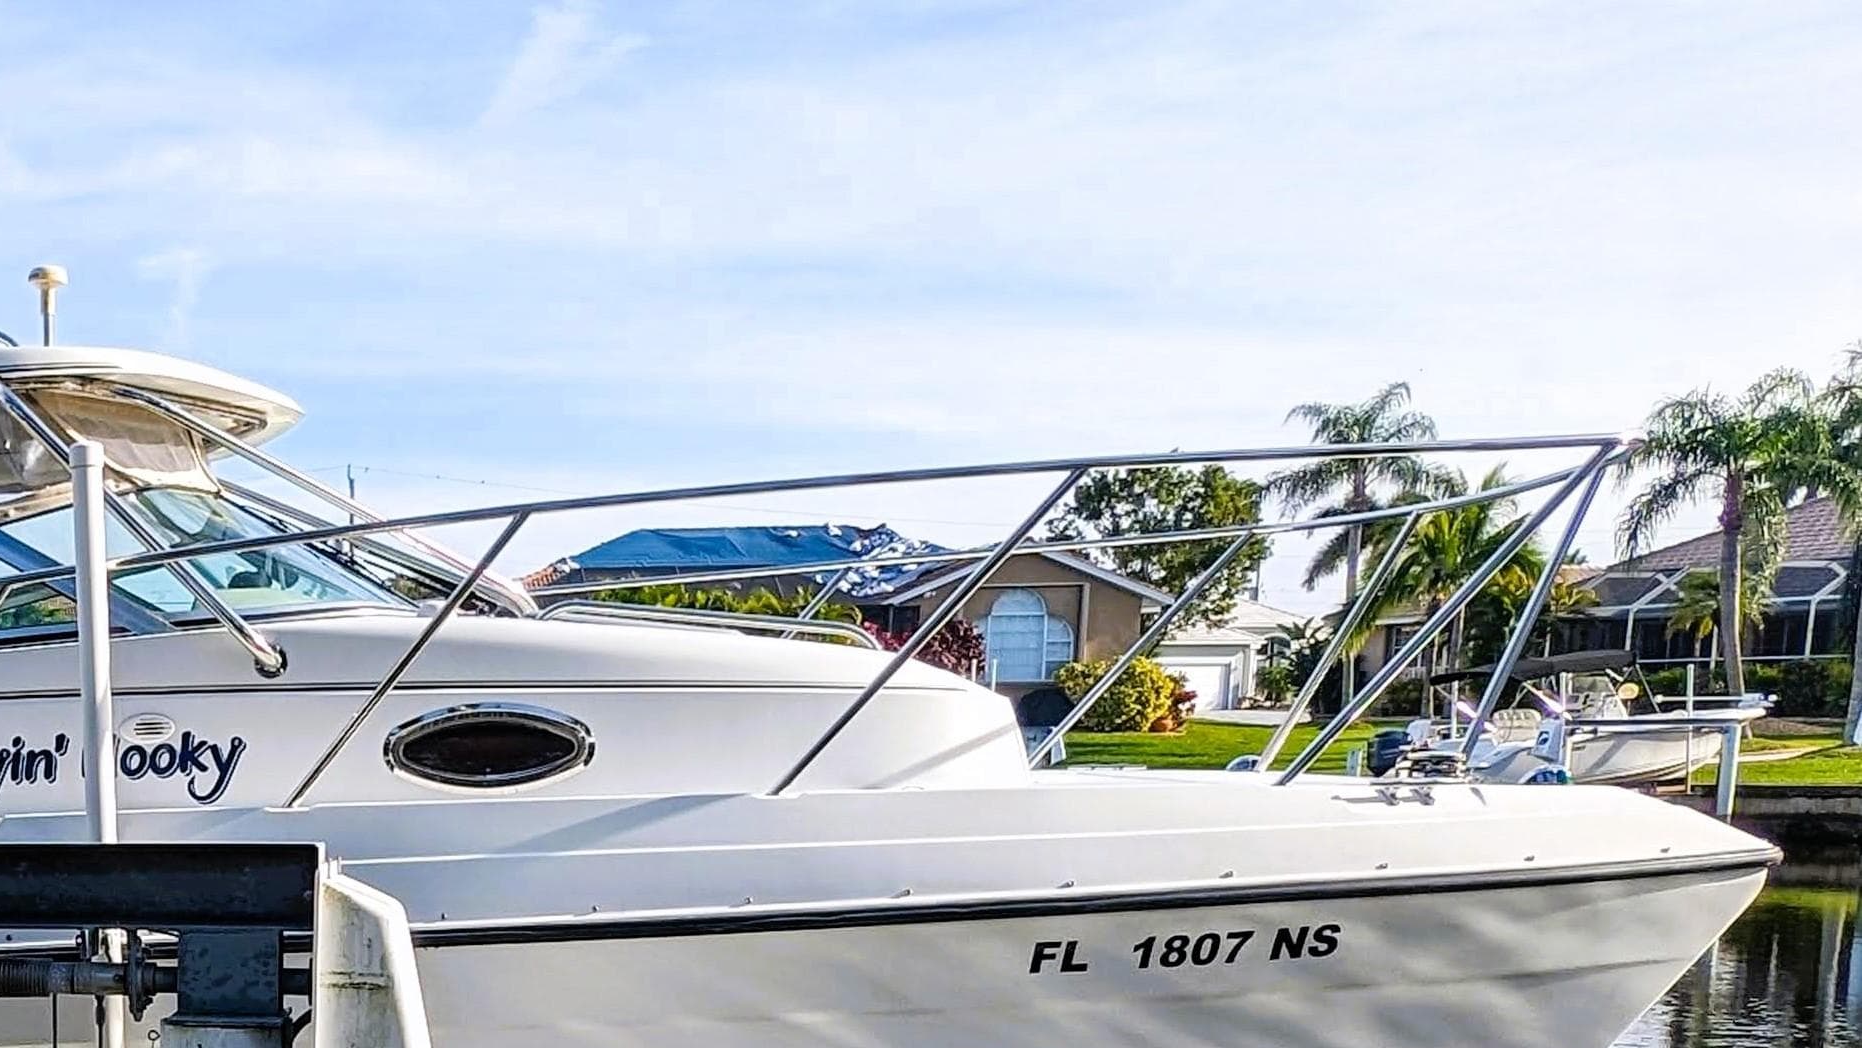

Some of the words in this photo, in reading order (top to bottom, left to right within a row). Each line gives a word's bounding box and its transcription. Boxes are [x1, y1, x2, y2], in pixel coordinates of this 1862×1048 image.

[81, 731, 246, 804] ooky
[1029, 940, 1088, 974] FL
[1133, 930, 1255, 969] 1807
[1269, 924, 1341, 960] NS
